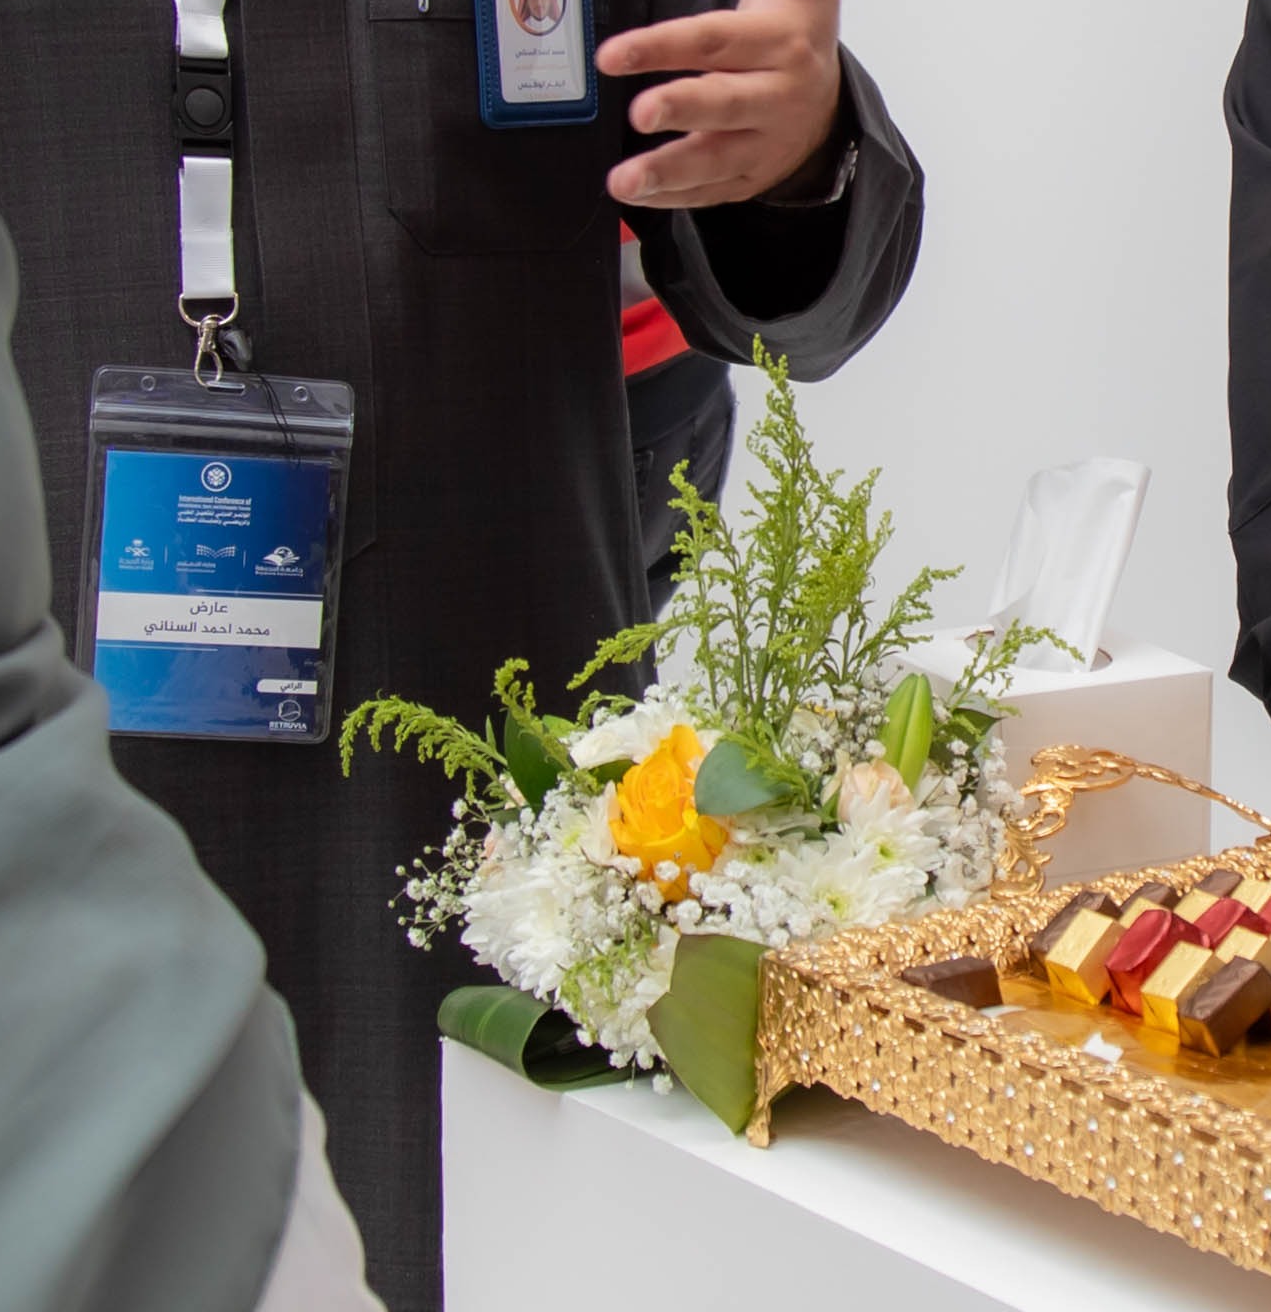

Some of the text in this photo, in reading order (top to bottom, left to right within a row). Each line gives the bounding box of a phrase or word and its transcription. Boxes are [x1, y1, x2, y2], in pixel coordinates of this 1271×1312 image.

[190, 601, 228, 615] عارض
[144, 620, 197, 636] السناني
[235, 626, 270, 636] محمد
